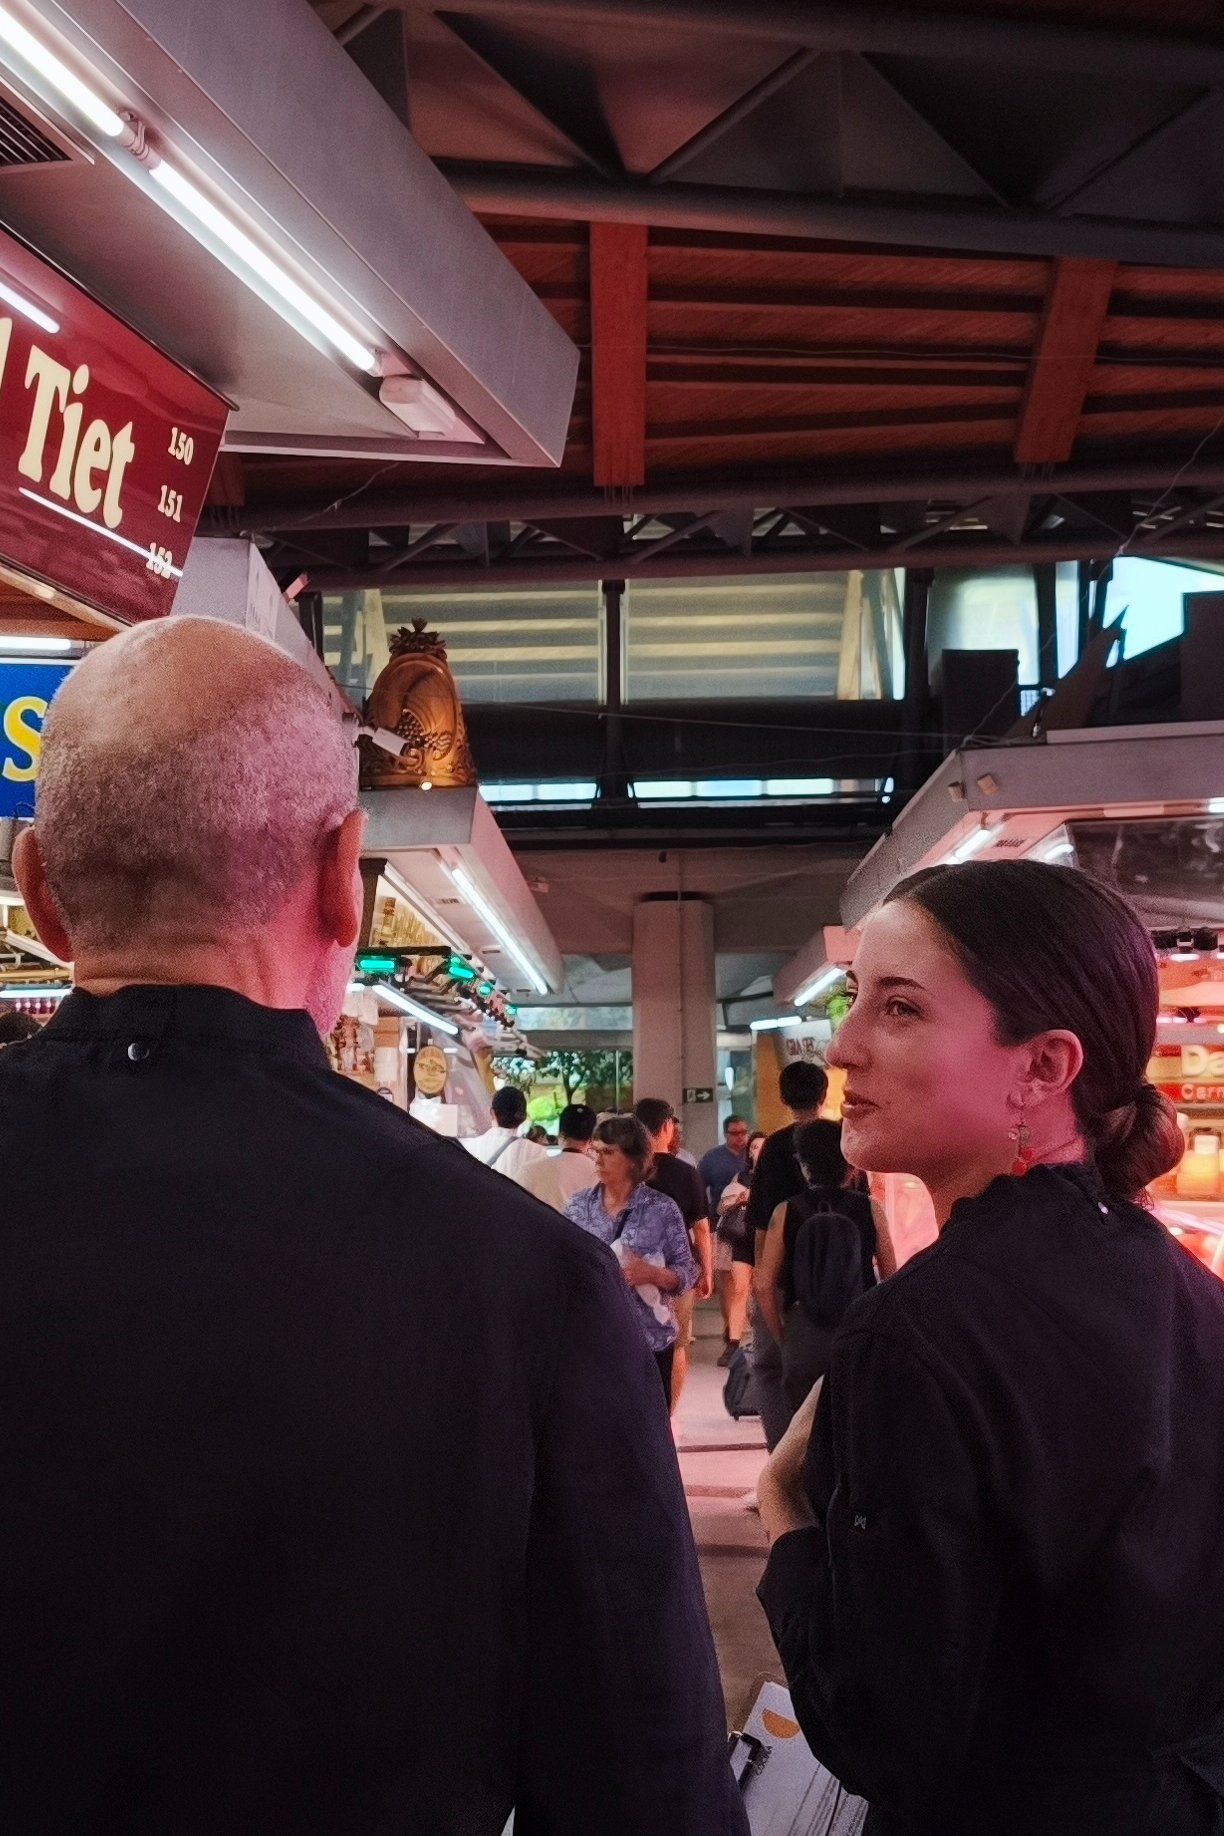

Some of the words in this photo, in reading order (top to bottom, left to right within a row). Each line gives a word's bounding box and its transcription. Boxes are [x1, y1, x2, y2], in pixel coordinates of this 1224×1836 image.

[18, 345, 135, 528] Tiet
[168, 427, 194, 465] 150
[157, 485, 183, 523] 151
